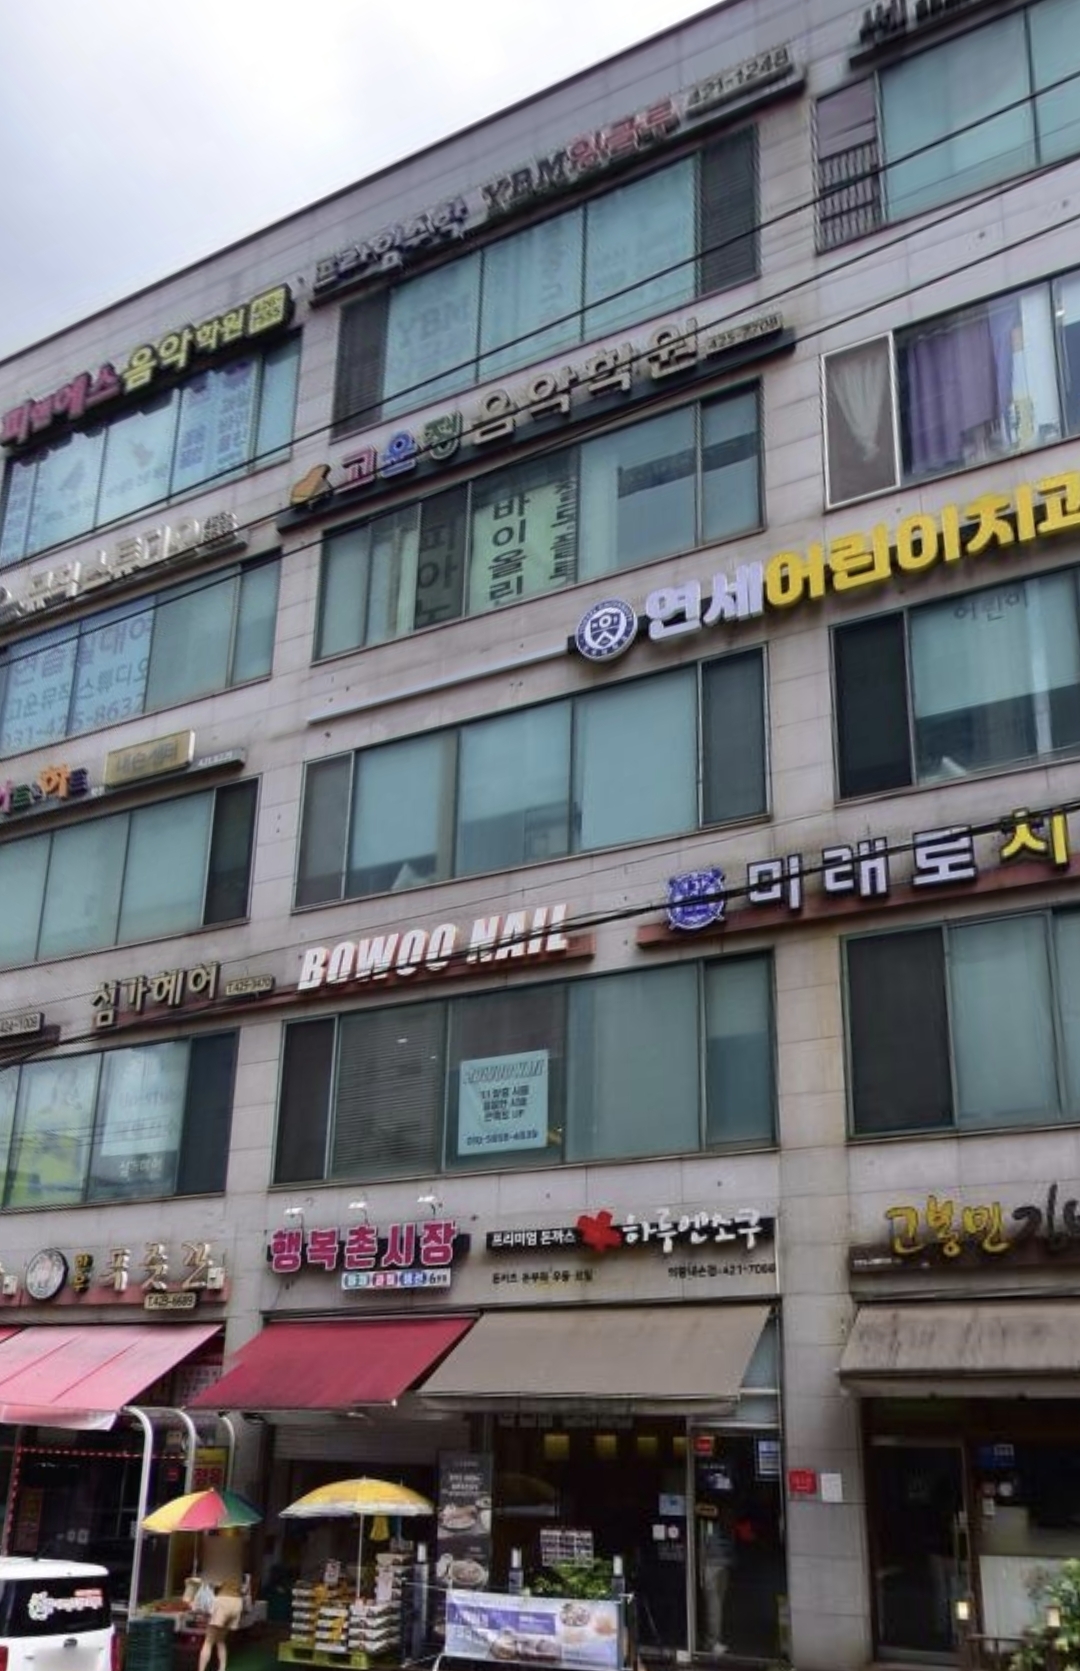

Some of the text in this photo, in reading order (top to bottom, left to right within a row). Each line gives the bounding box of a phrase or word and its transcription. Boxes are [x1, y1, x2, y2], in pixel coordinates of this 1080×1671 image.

[121, 307, 247, 394] 음악학원
[466, 902, 569, 965] NAIL
[93, 962, 220, 1027] 심가헤어
[271, 1220, 457, 1273] 행복촌시장
[491, 1229, 576, 1247] 프리미엄 돈까스
